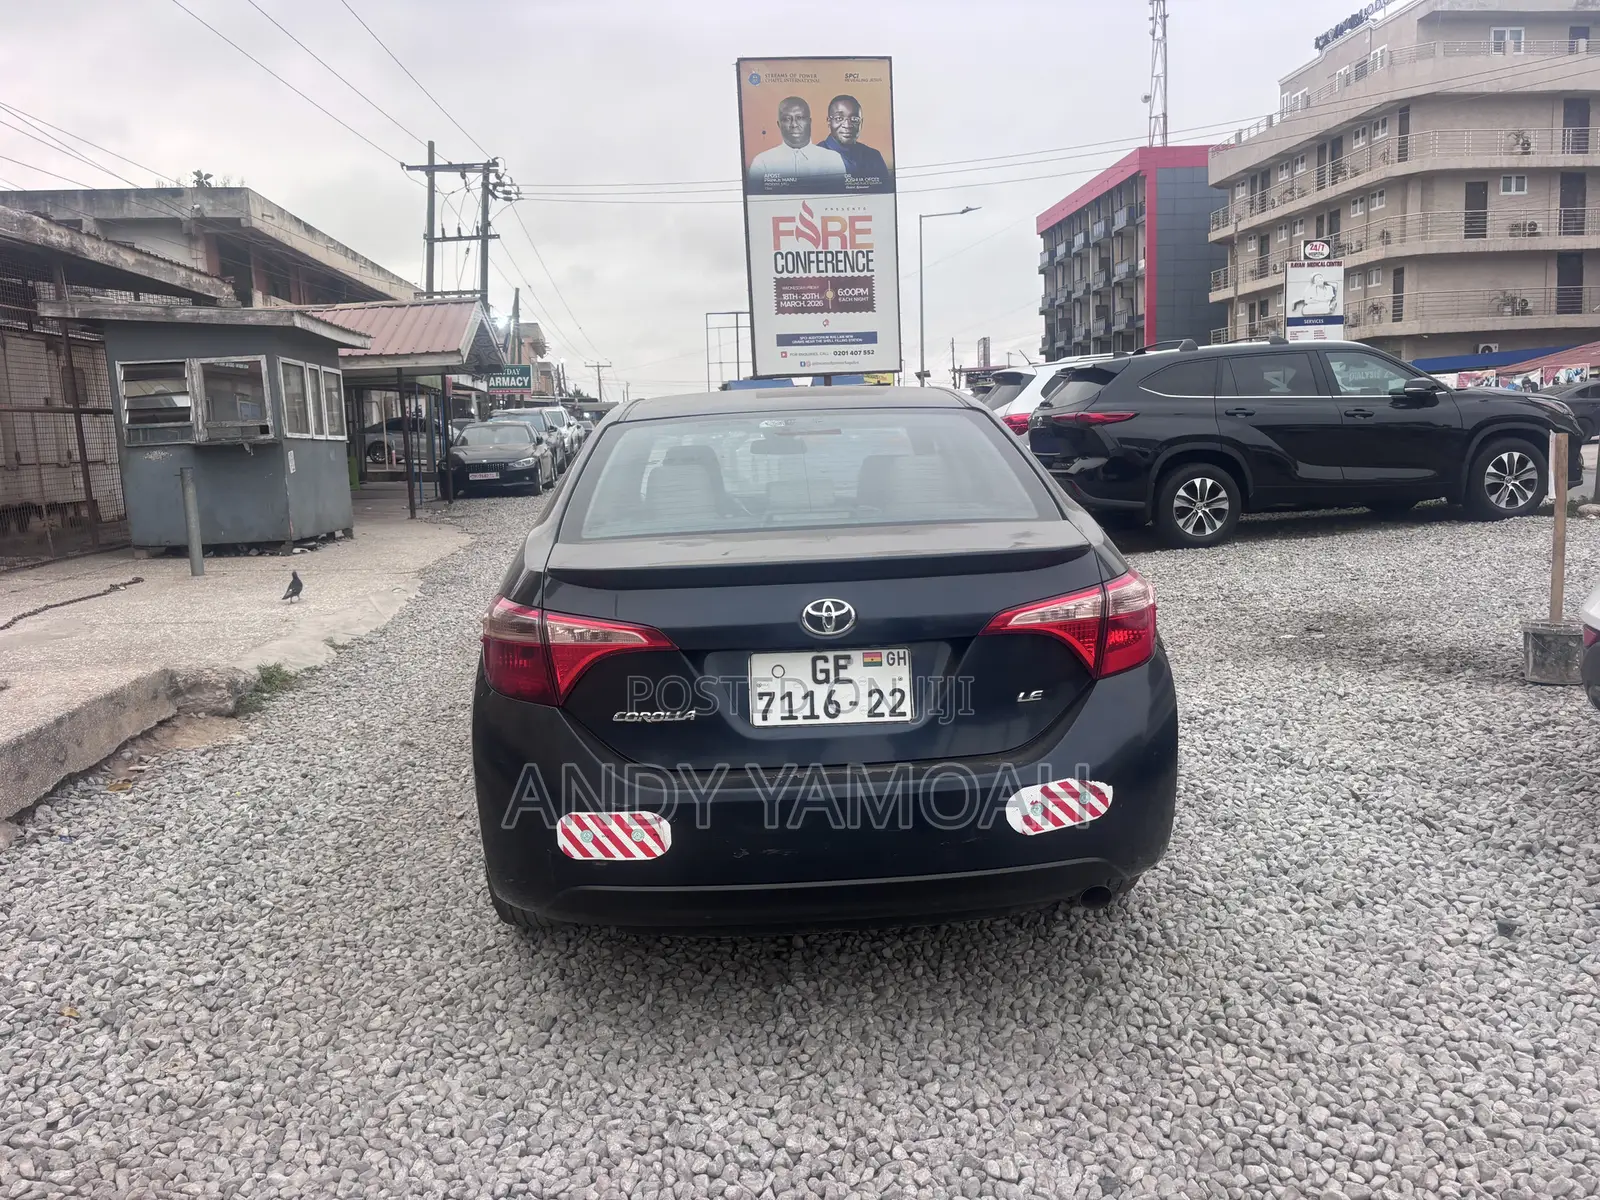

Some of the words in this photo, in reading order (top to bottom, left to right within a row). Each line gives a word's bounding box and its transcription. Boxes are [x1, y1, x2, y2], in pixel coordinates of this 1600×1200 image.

[1310, 243, 1325, 252] 24/7
[773, 250, 875, 275] CONFERENCE
[801, 292, 820, 300] 20TH
[837, 288, 869, 296] 6:00PM
[488, 376, 530, 387] ARMACY
[811, 655, 853, 685] GE
[886, 650, 907, 666] GH
[1017, 689, 1044, 703] LE
[757, 688, 907, 722] 7116-22
[612, 709, 697, 723] COROLLA
